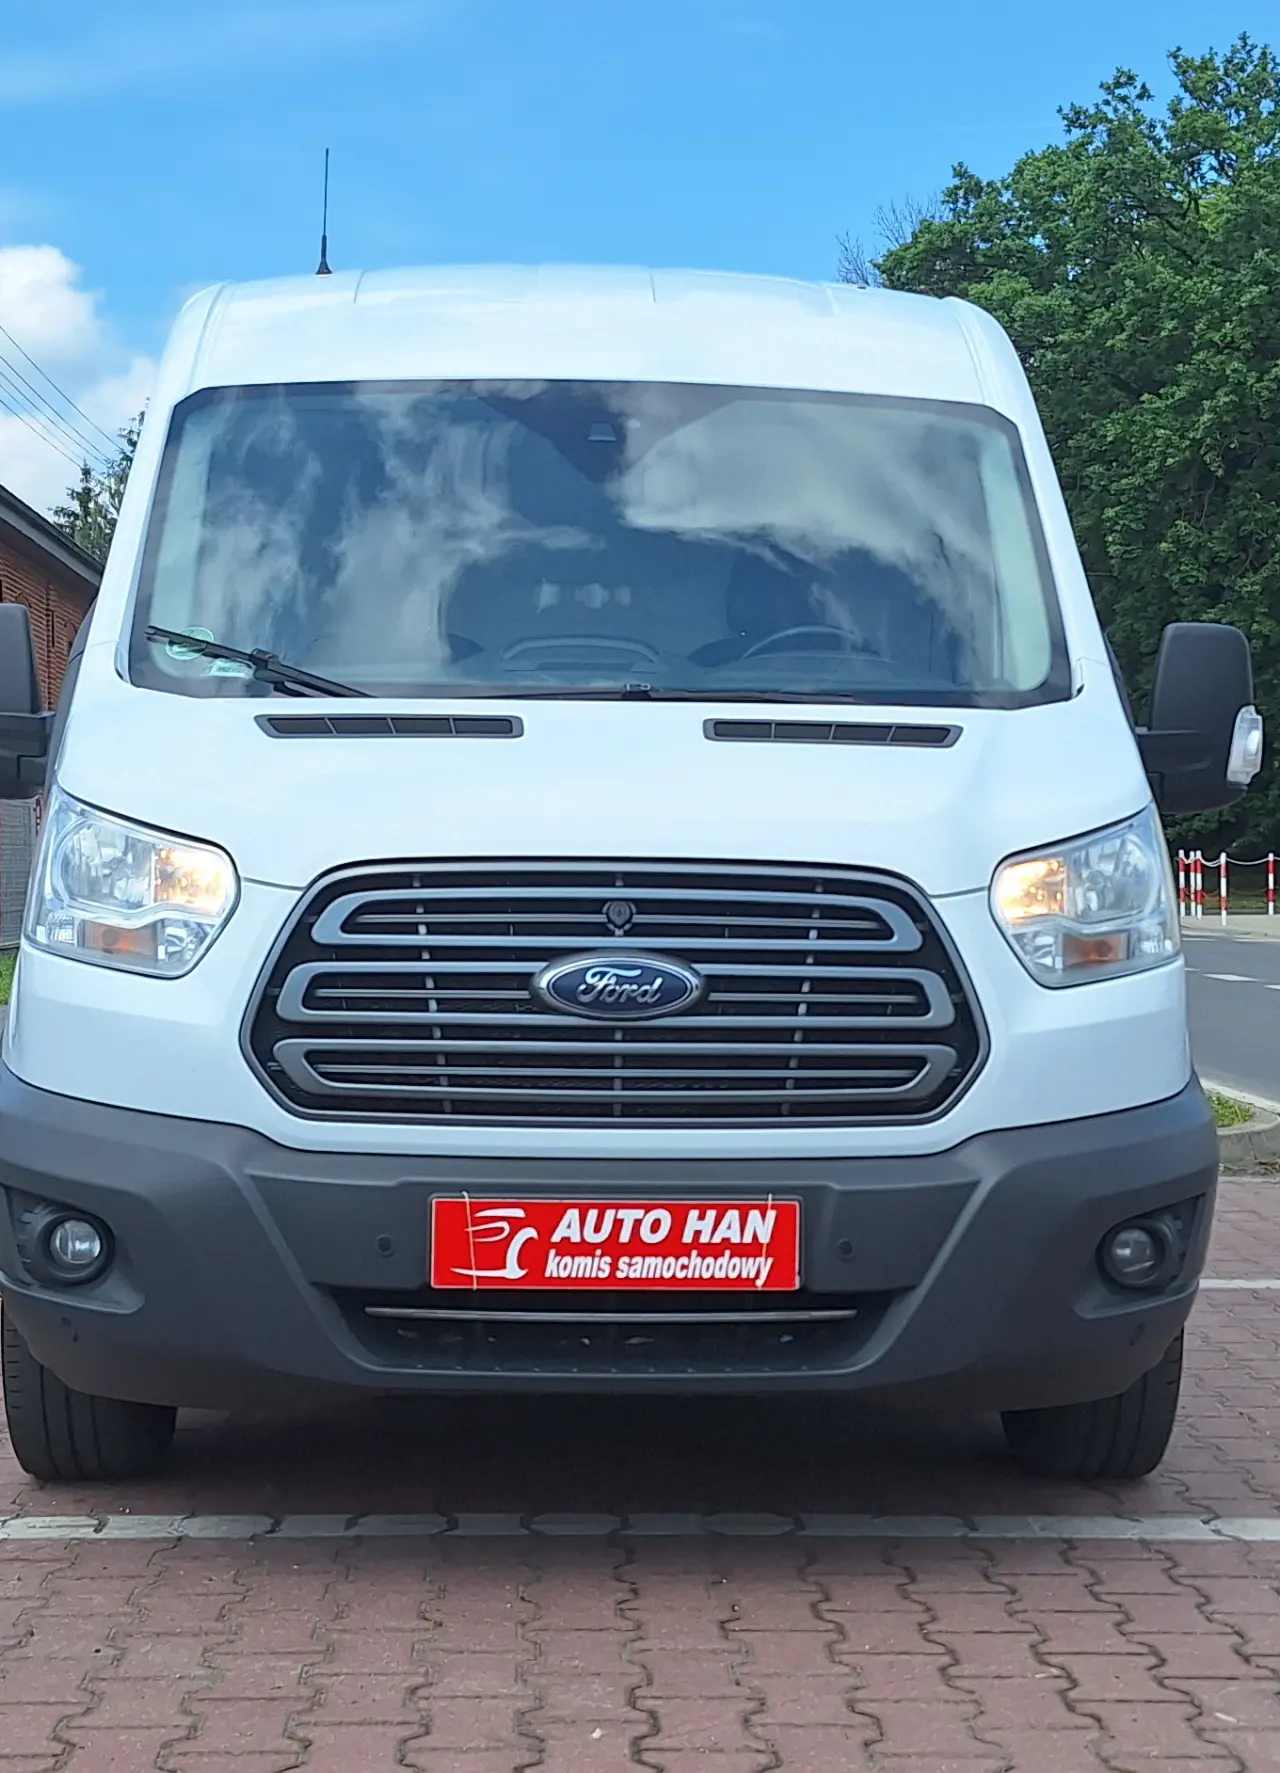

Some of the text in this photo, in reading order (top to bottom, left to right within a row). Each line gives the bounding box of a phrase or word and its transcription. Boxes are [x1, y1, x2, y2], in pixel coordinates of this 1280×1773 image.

[576, 966, 664, 1004] Ford
[550, 1207, 777, 1245] AUTO HAN
[544, 1249, 775, 1287] komis samochodowy
